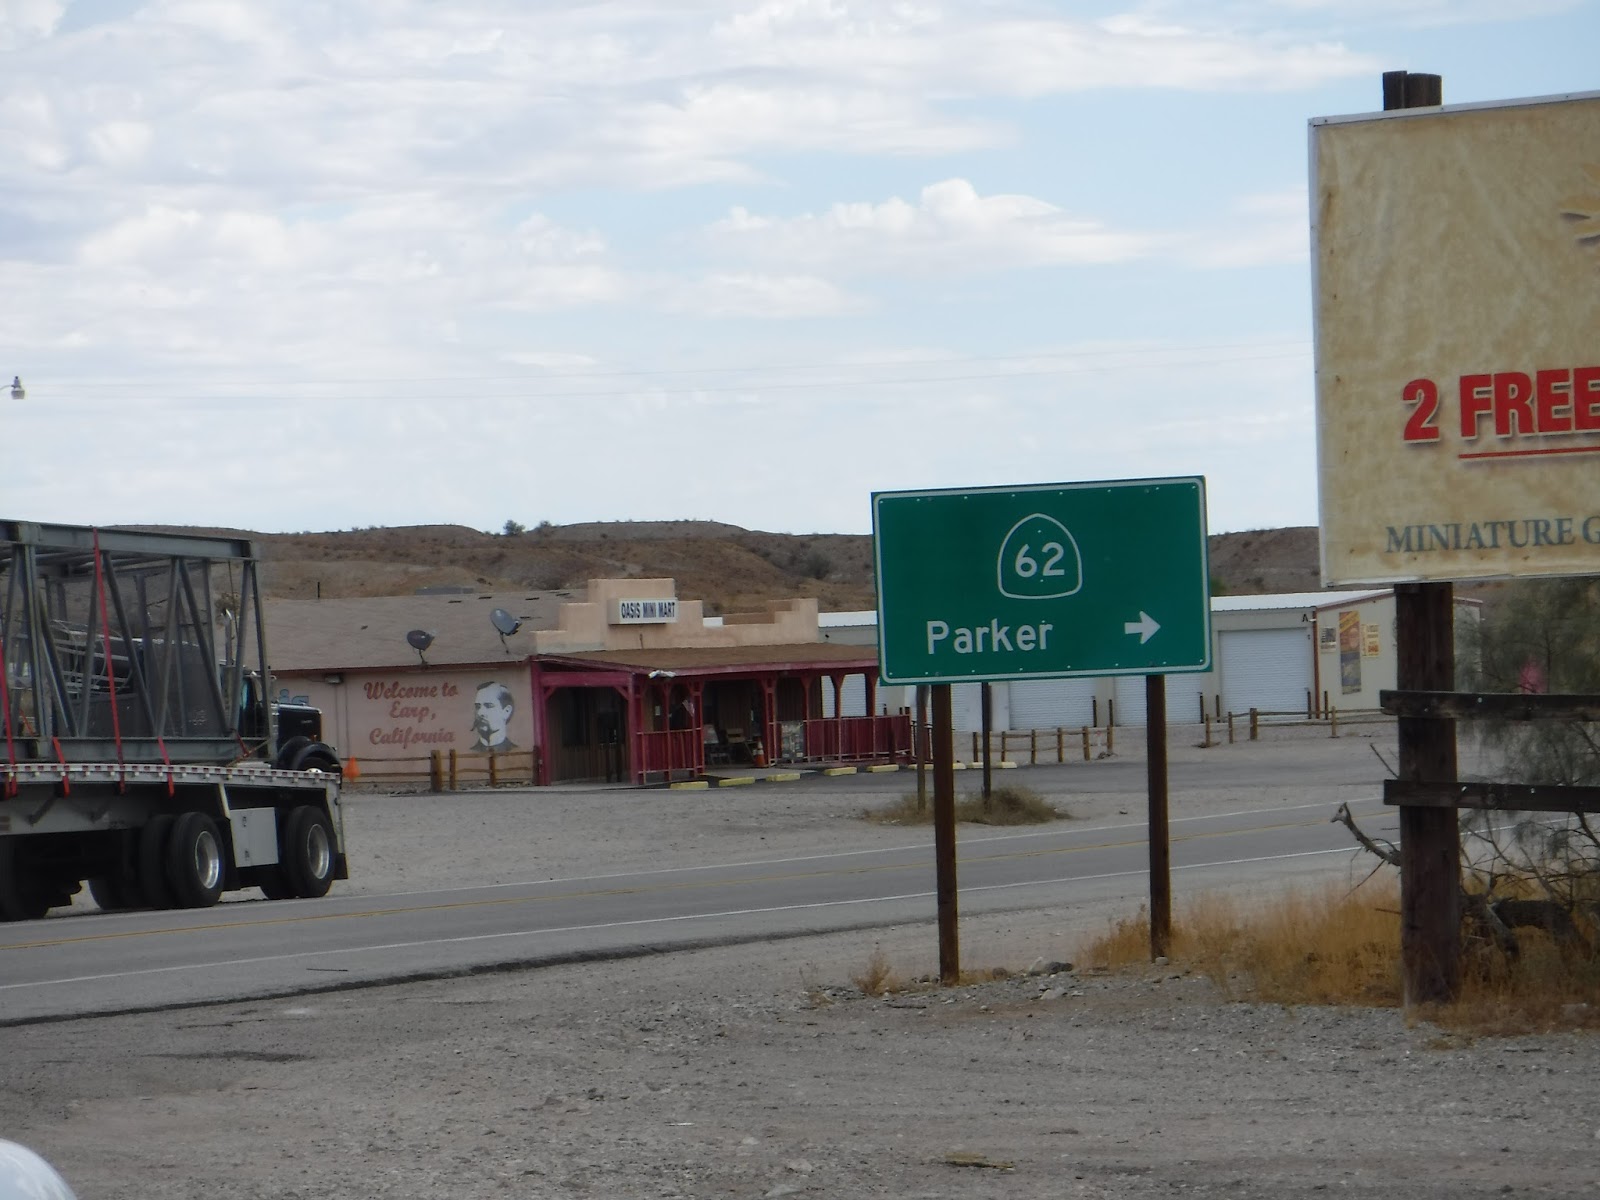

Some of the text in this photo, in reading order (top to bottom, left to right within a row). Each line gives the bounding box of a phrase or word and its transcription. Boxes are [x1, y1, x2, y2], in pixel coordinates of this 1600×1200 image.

[1402, 366, 1600, 441] 2 FREE
[1385, 518, 1576, 554] MINIATURE
[1015, 541, 1065, 578] 62
[621, 601, 676, 619] OASIS MINI MART
[926, 618, 1054, 655] Parker
[363, 681, 459, 700] Welcome to
[389, 700, 437, 723] Earp,
[369, 726, 456, 749] California
